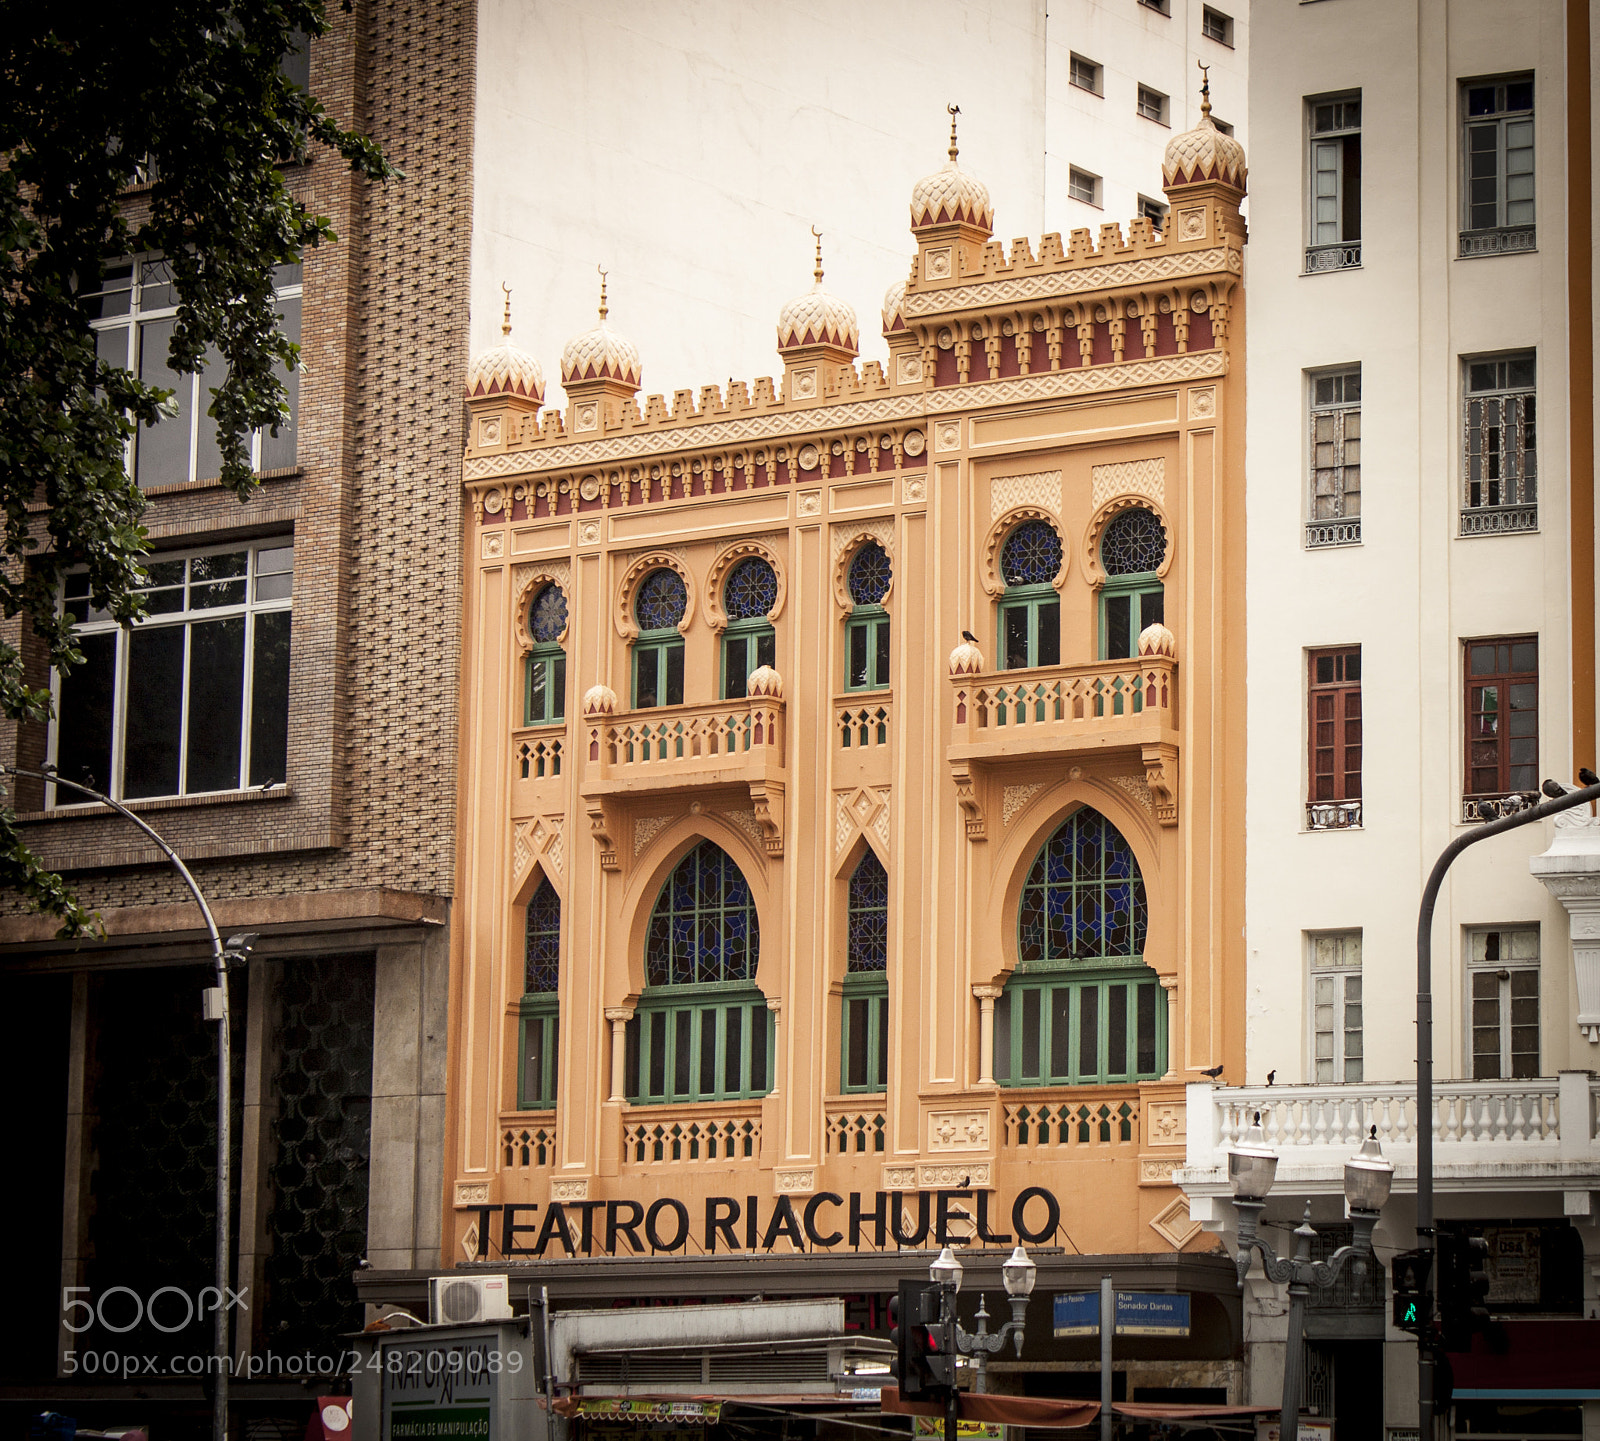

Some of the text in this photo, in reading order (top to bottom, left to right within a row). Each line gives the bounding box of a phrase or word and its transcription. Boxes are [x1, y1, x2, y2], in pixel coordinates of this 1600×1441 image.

[468, 1187, 1060, 1256] TEATRO RIACHUELO
[1118, 1293, 1132, 1301] Rua
[1118, 1302, 1173, 1311] Senador Dantas
[393, 1418, 489, 1438] FARMÁCIA DE MANIPULAÇÃO
